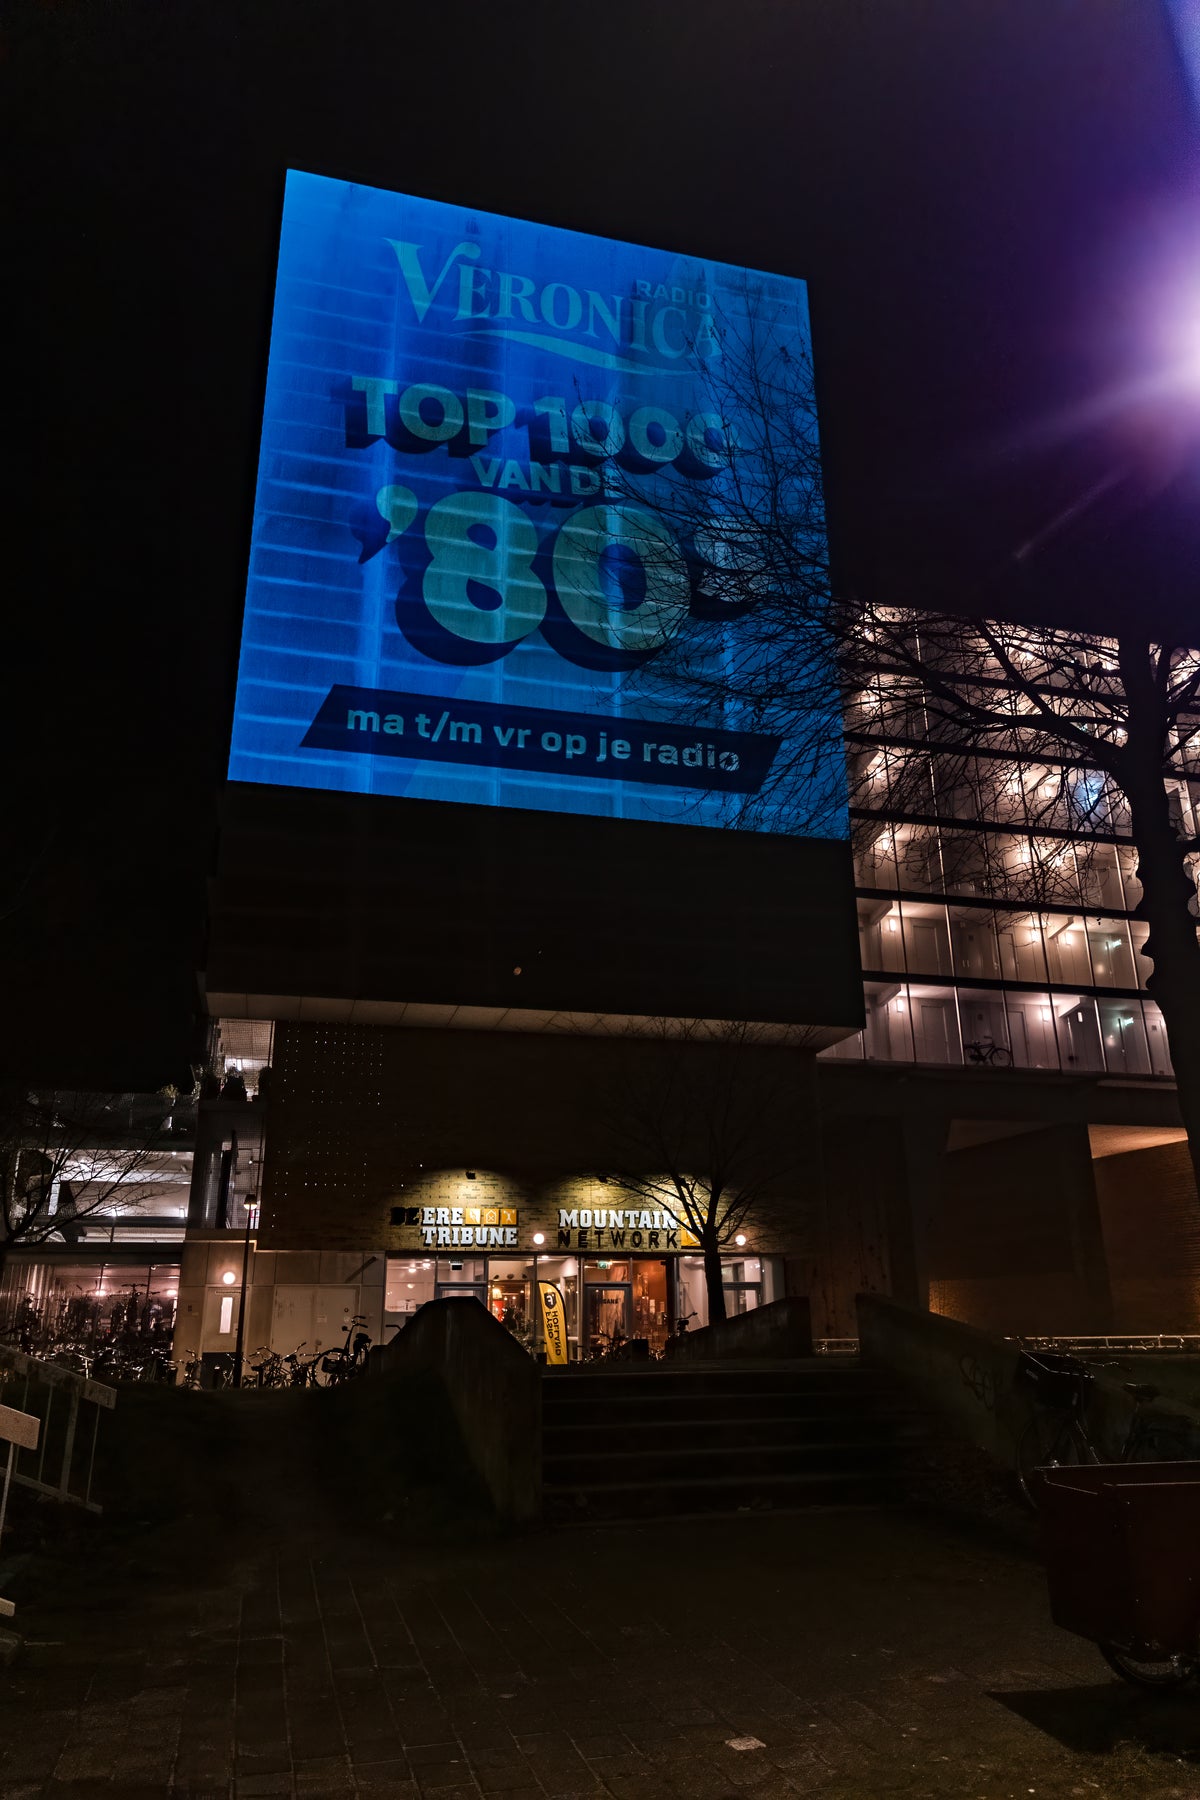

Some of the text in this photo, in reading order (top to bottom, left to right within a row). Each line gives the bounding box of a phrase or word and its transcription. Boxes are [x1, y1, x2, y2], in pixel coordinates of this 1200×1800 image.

[382, 238, 722, 360] VERONICA
[635, 279, 711, 309] RADIO
[351, 375, 740, 468] TOP 1000
[469, 456, 563, 493] VAN
[347, 709, 740, 772] ma t/m vr op je radio
[559, 1209, 678, 1229] MOUNTAIN
[421, 1227, 518, 1246] TRIBUNE
[558, 1230, 678, 1248] NETWORK
